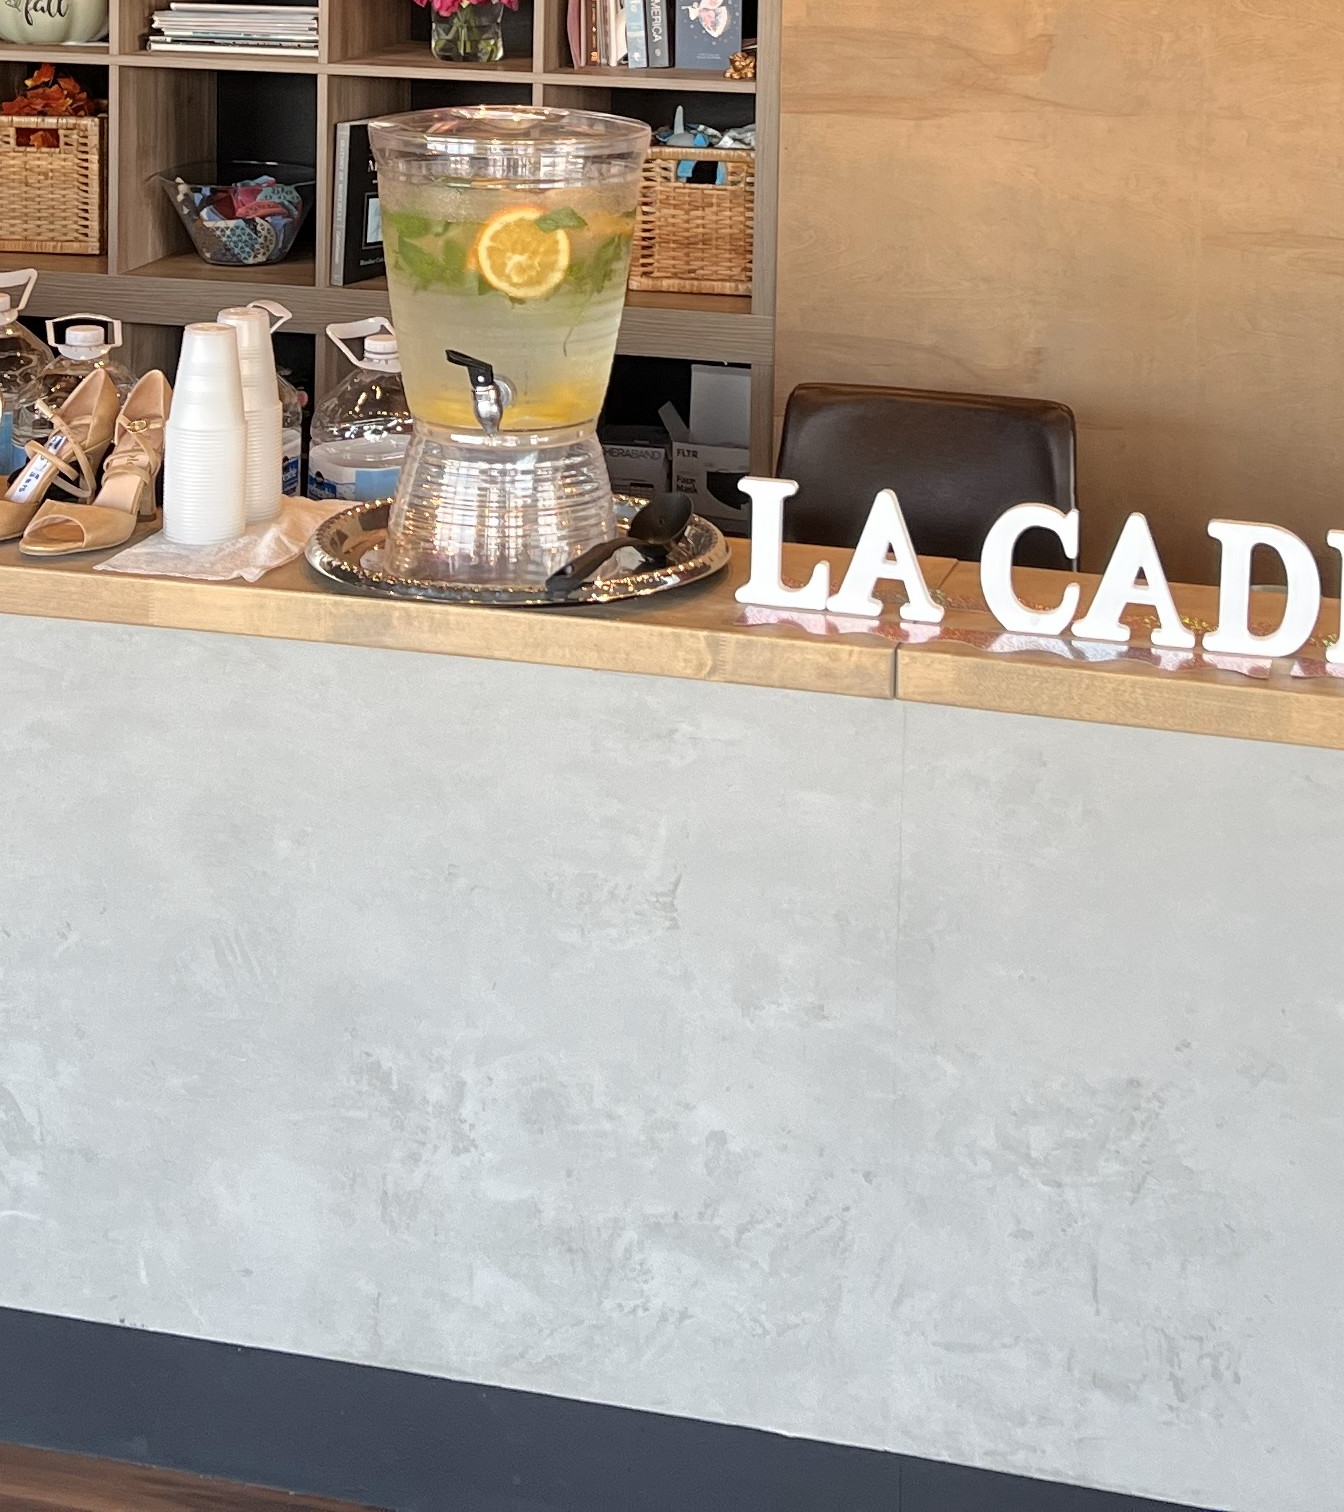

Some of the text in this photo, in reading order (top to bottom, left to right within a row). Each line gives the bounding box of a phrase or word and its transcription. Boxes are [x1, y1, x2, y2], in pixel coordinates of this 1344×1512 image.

[604, 447, 661, 461] HERABAND
[677, 448, 698, 459] FLTR
[735, 474, 945, 623] LA
